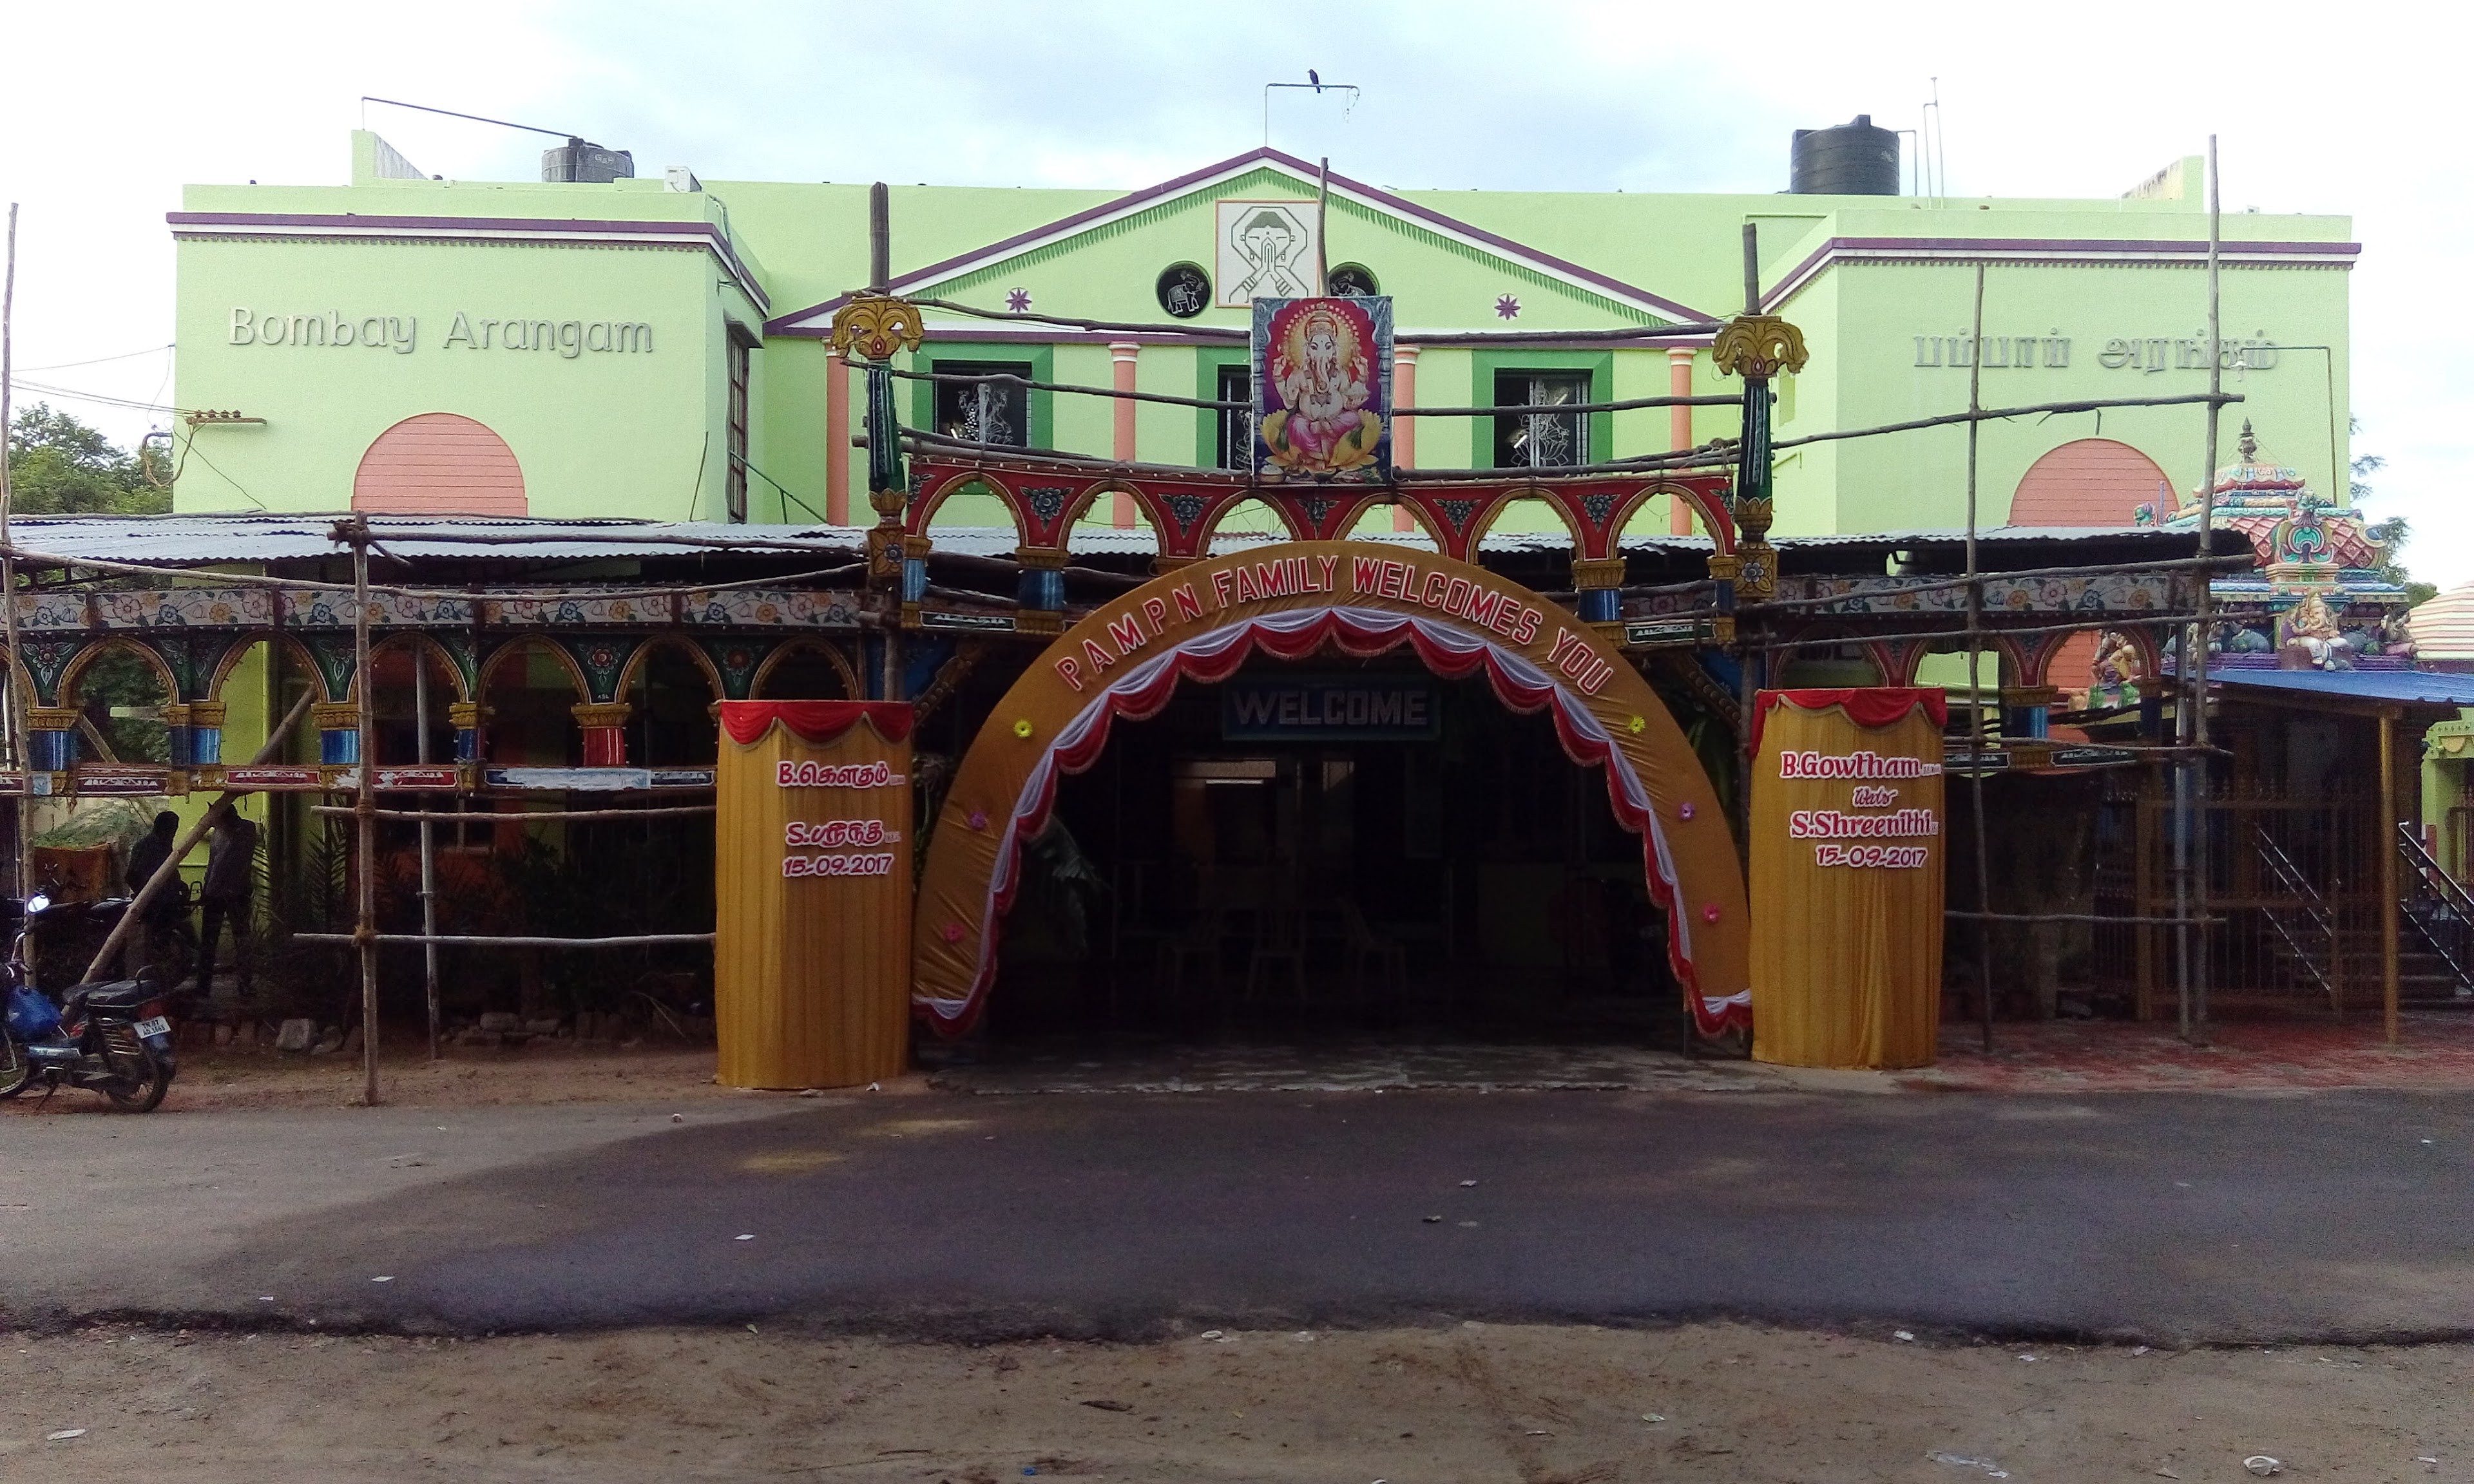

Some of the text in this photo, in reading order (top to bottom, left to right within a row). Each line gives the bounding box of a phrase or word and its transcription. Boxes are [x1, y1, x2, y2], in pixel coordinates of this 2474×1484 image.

[228, 307, 653, 358] Bombay Arangam
[1913, 327, 2071, 368] பம்பாய்
[1211, 555, 1339, 609] FAMILY
[1354, 556, 1542, 645] WELCOMES
[1547, 627, 1613, 696] YOU
[1232, 690, 1428, 725] WELCOME
[1781, 753, 1920, 777] B.Gowtham
[1791, 810, 1932, 836] S.Shreenithi
[783, 855, 892, 875] 15-09-2017
[1817, 847, 1927, 866] 15-09-2017
